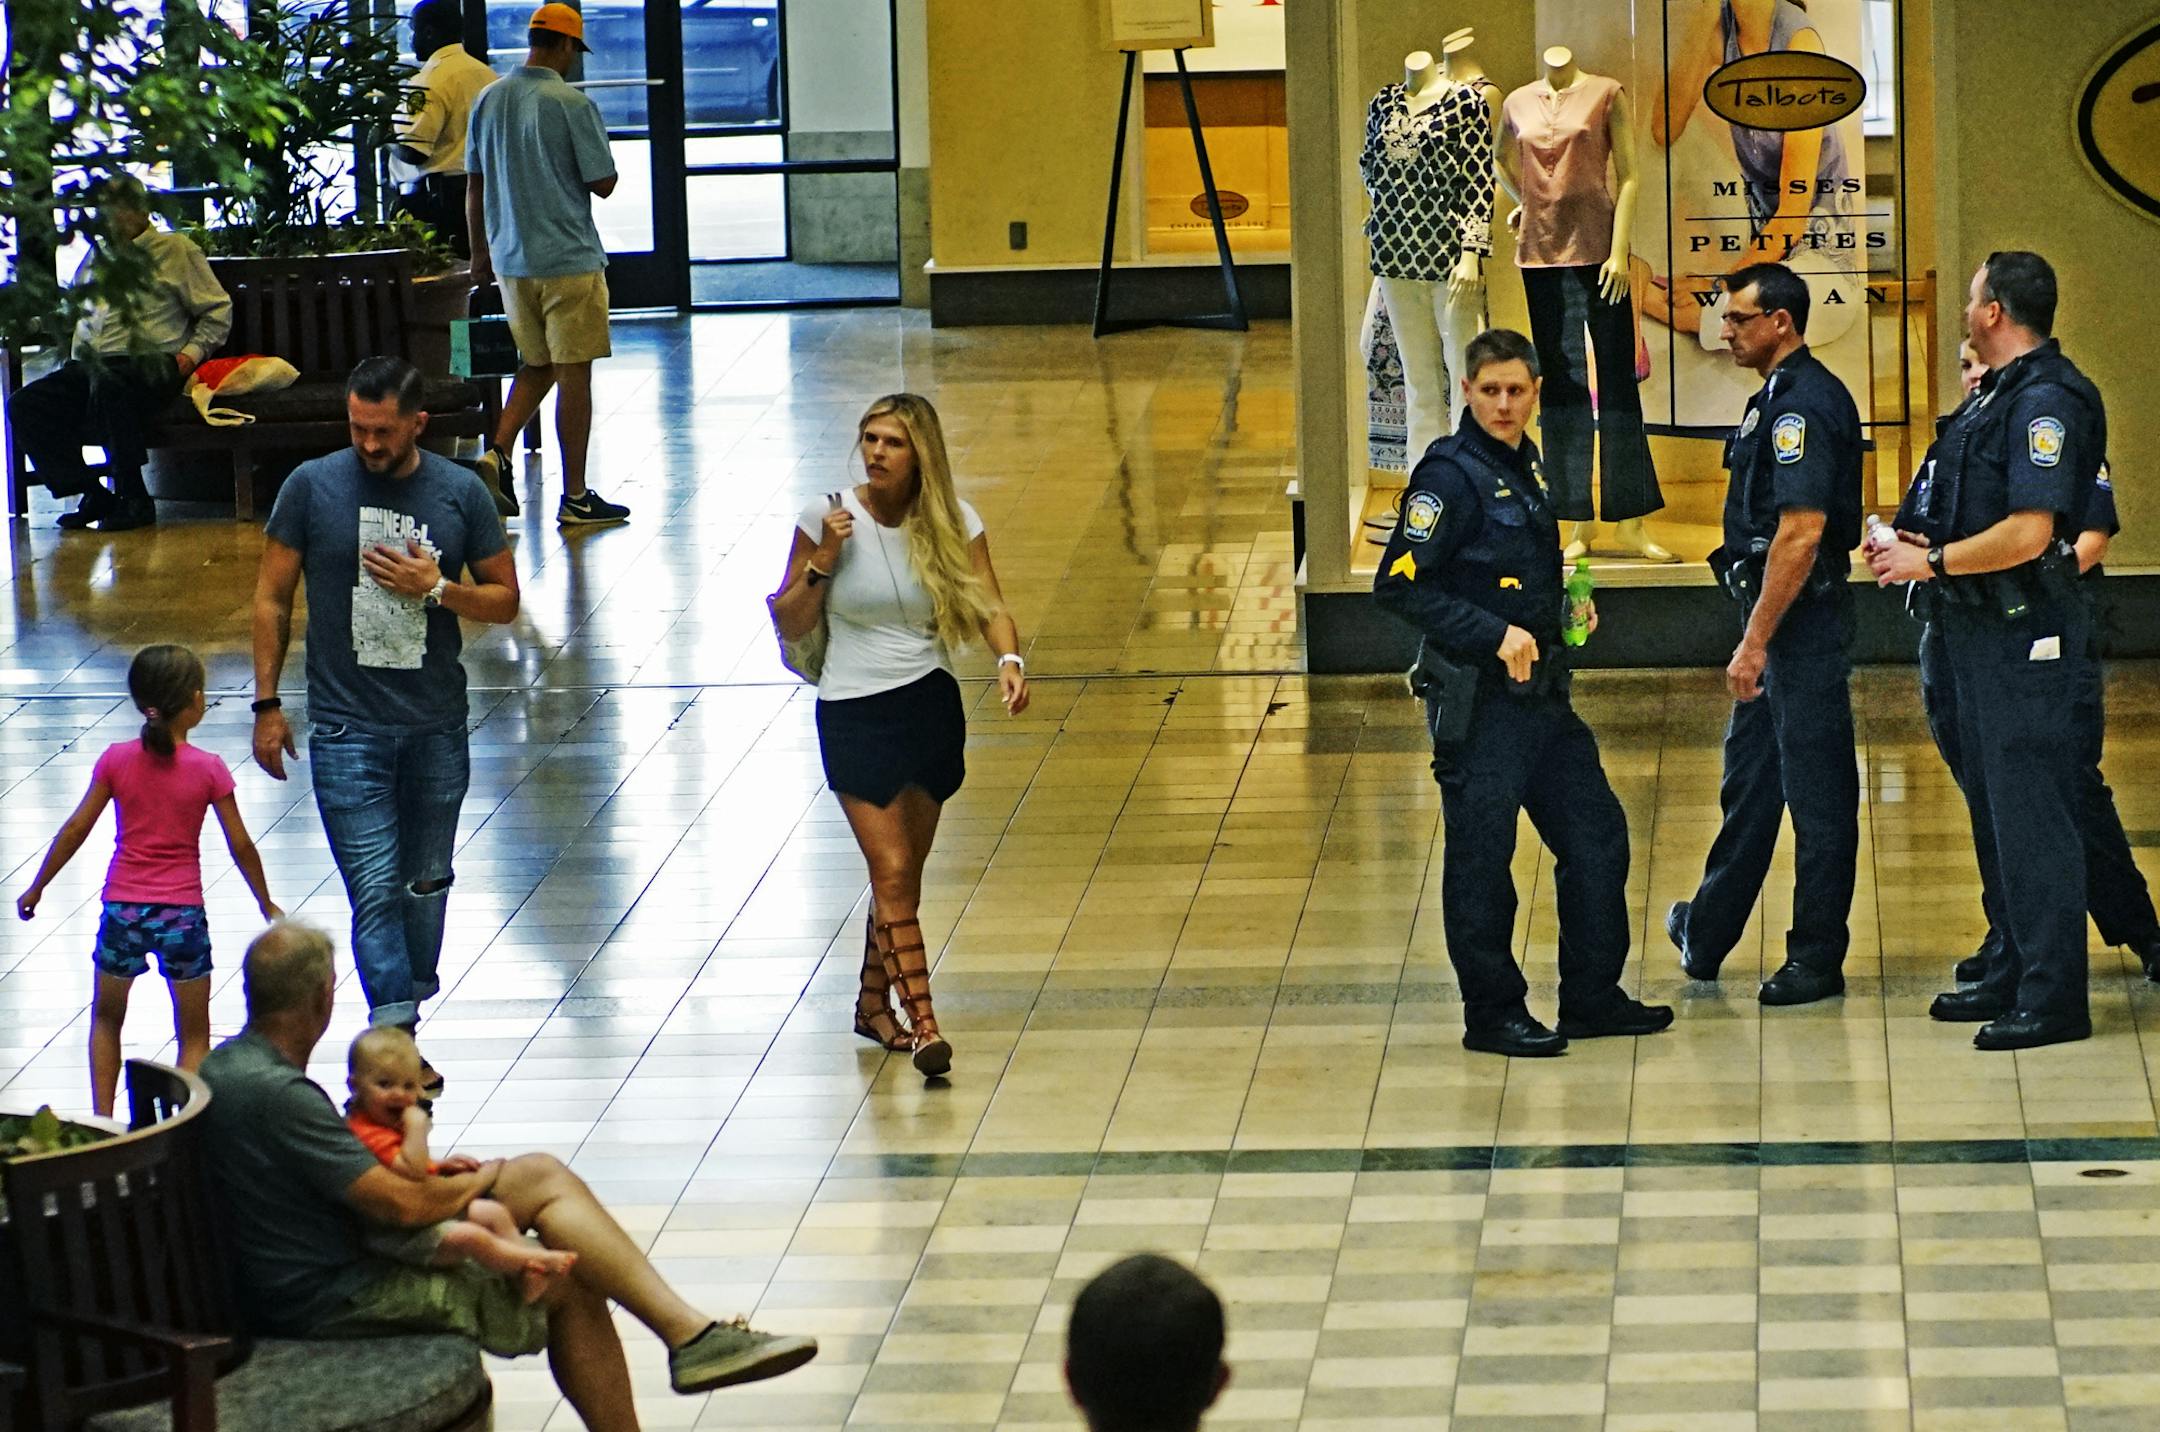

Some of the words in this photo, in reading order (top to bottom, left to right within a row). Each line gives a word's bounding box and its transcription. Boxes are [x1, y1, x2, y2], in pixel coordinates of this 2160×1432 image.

[1718, 76, 1853, 108] Talbots
[1713, 177, 1861, 197] MISSES
[1690, 231, 1886, 253] PETITES
[1691, 287, 1887, 308] WAN
